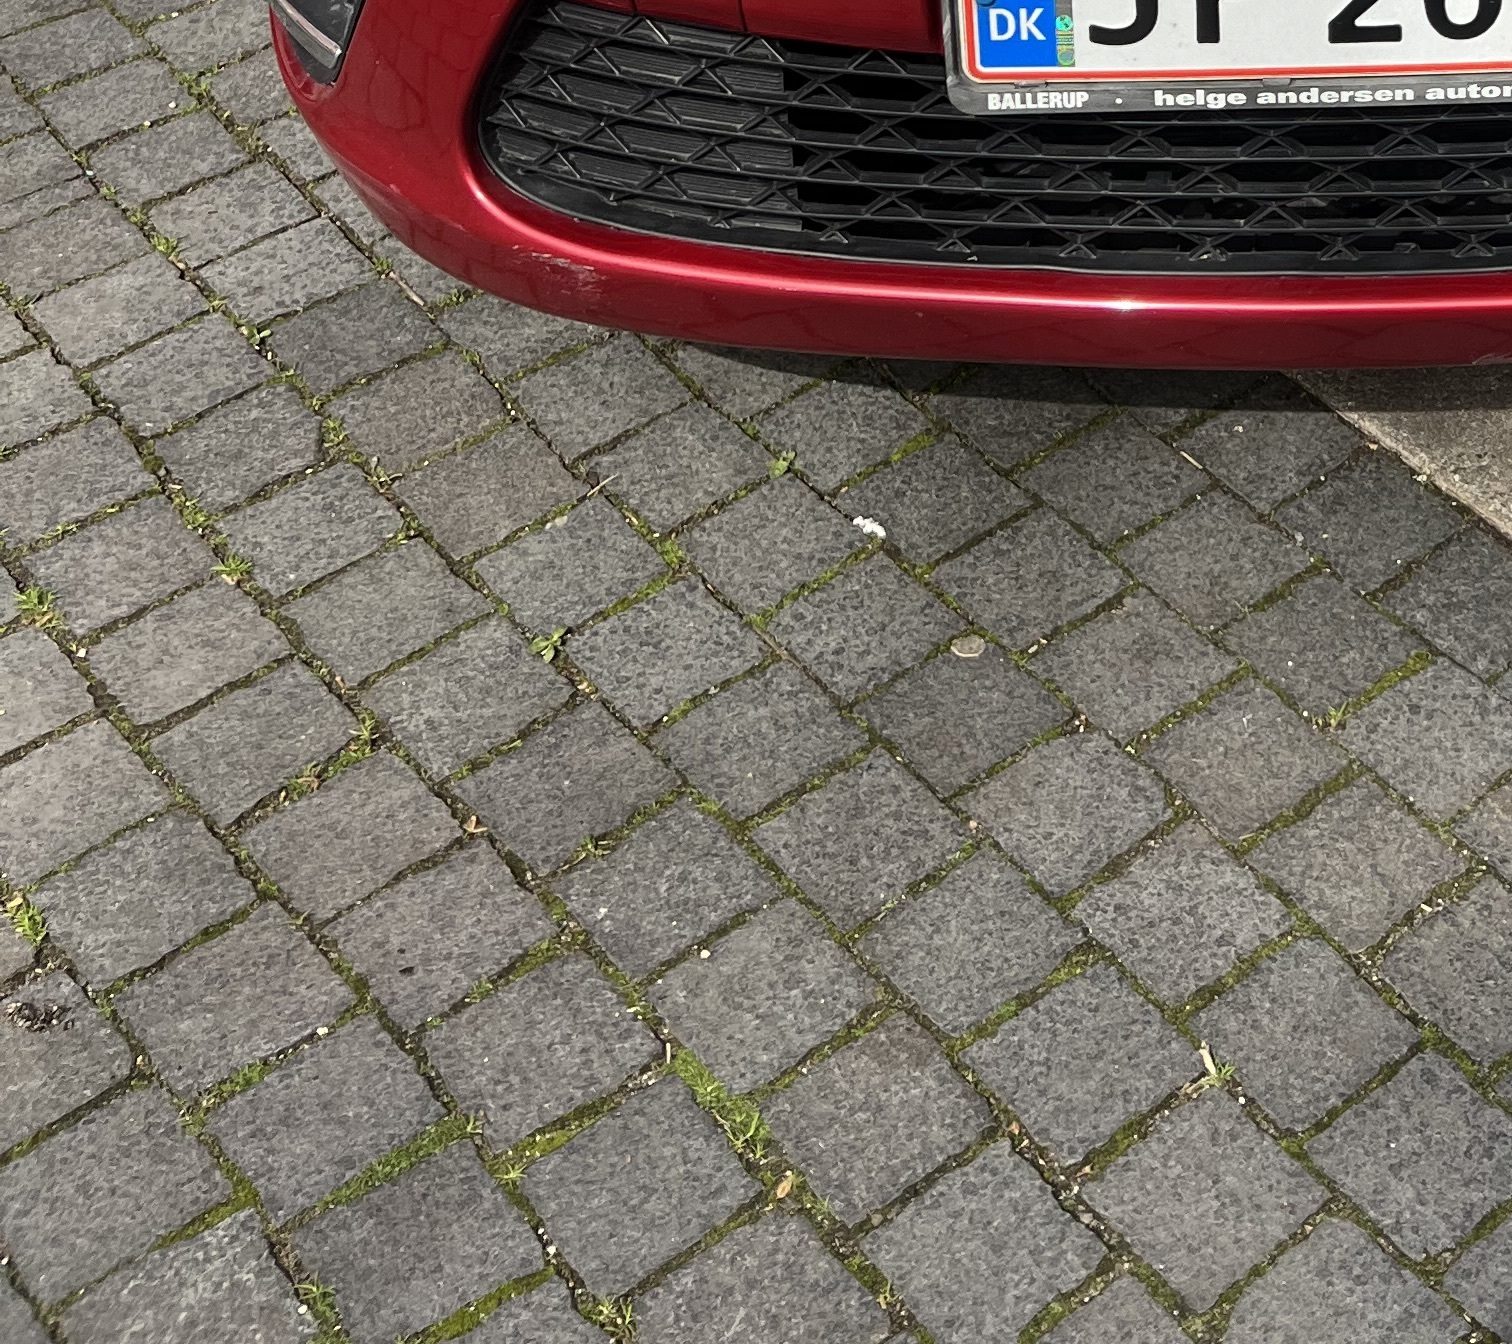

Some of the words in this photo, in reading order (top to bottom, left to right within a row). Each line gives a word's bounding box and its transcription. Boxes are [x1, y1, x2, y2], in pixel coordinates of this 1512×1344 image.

[988, 7, 1047, 42] DK
[986, 90, 1090, 110] BALLERUP
[1153, 88, 1247, 109] helge
[1255, 84, 1415, 105] andersen
